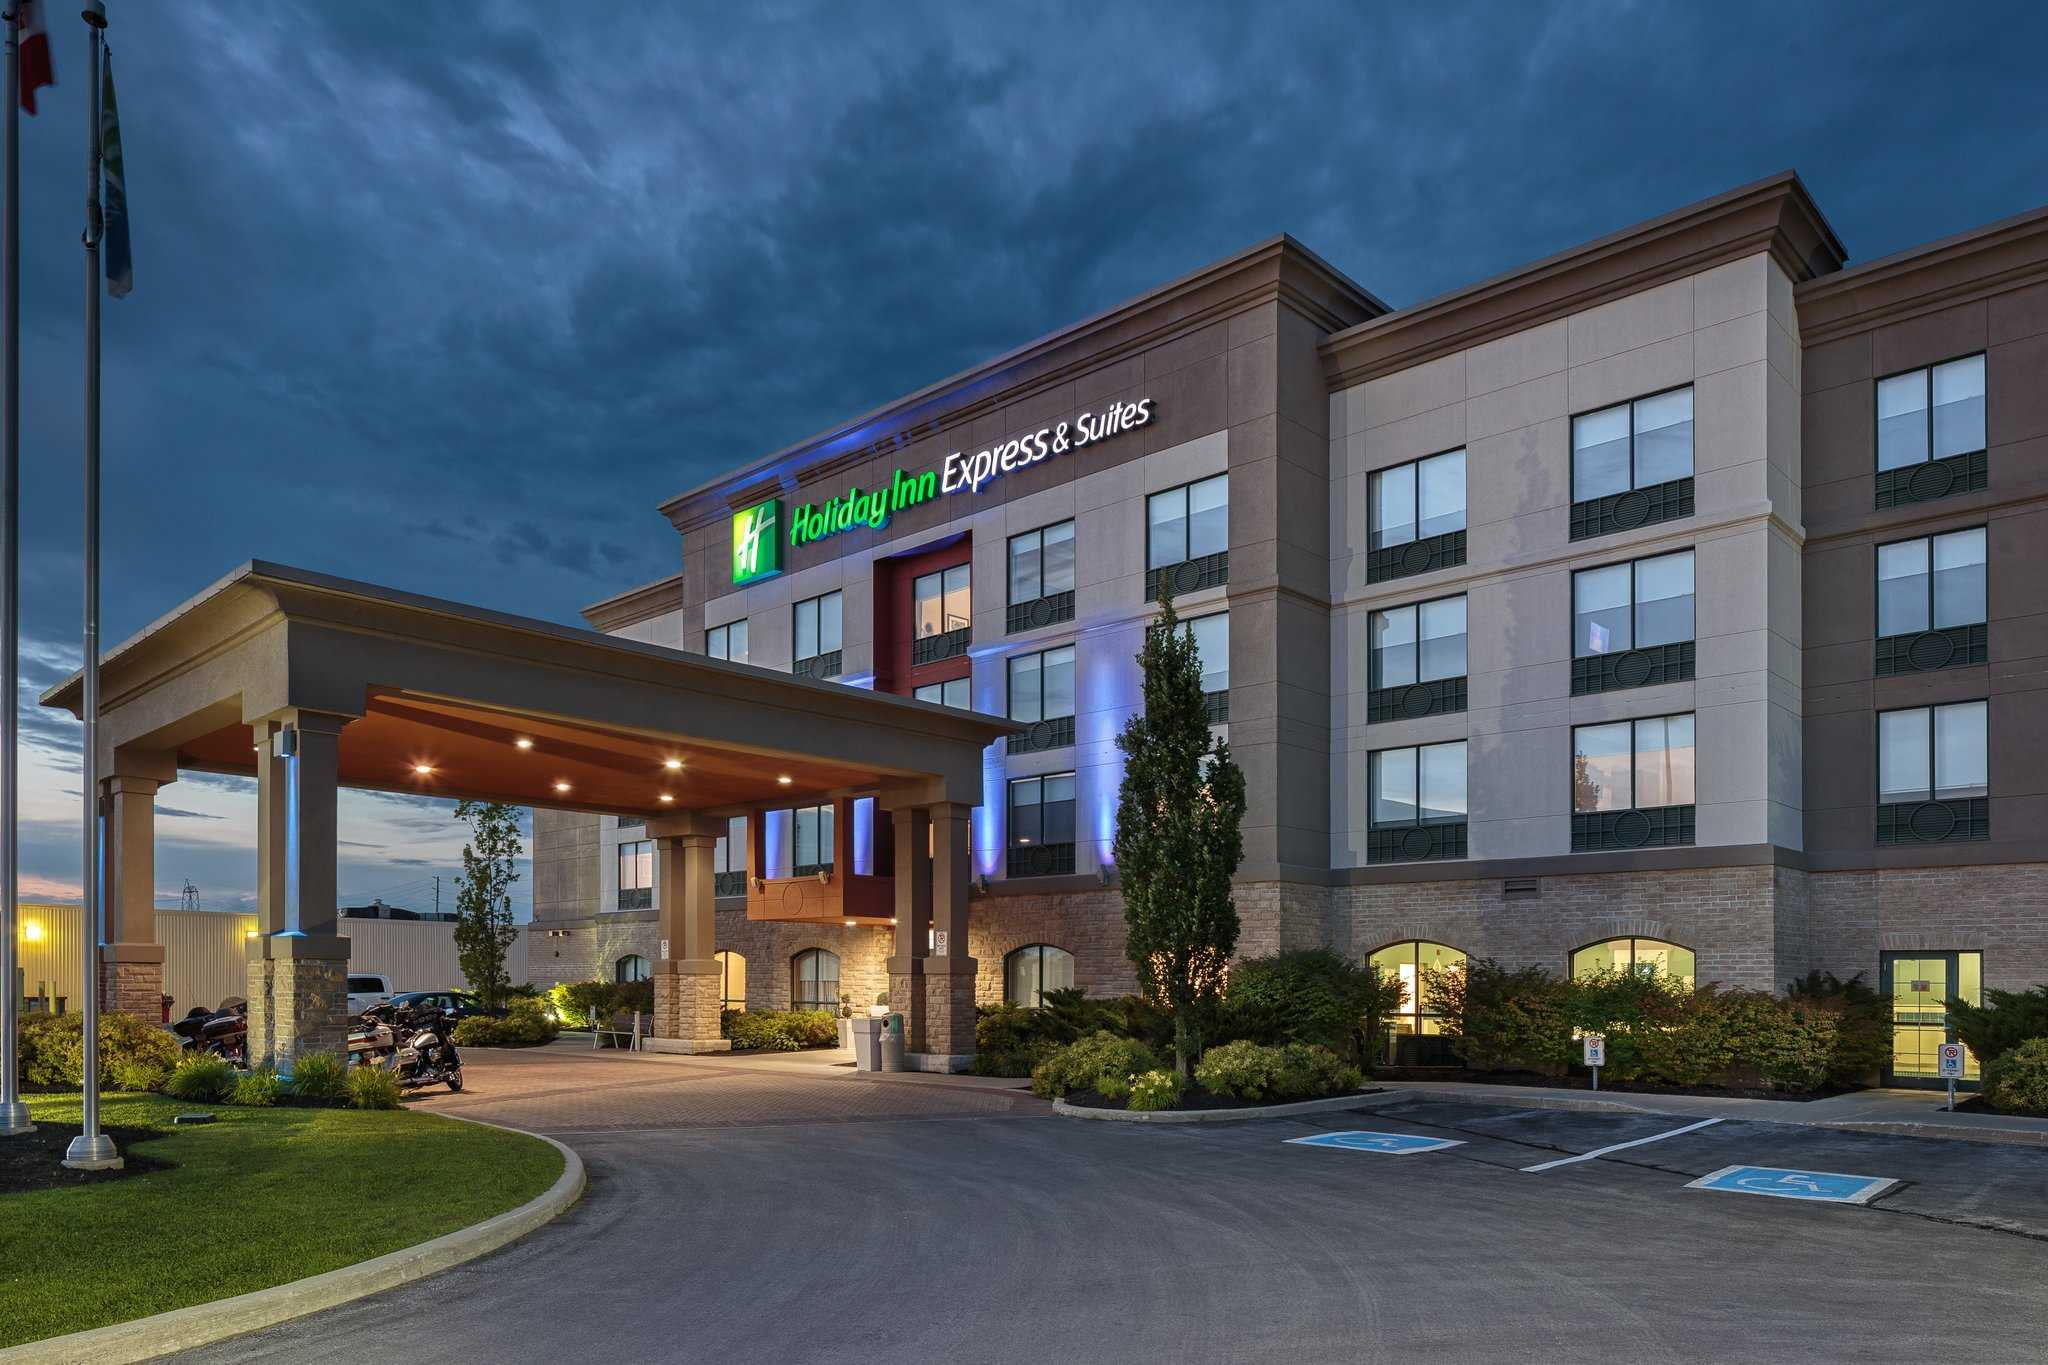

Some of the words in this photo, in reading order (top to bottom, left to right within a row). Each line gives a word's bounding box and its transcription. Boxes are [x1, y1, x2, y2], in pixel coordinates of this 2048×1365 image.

[790, 487, 888, 546] Holiday
[891, 469, 936, 511] Inn
[941, 429, 1049, 493] Express
[1052, 422, 1070, 454] &
[1074, 398, 1151, 446] Suites
[737, 507, 775, 574] H
